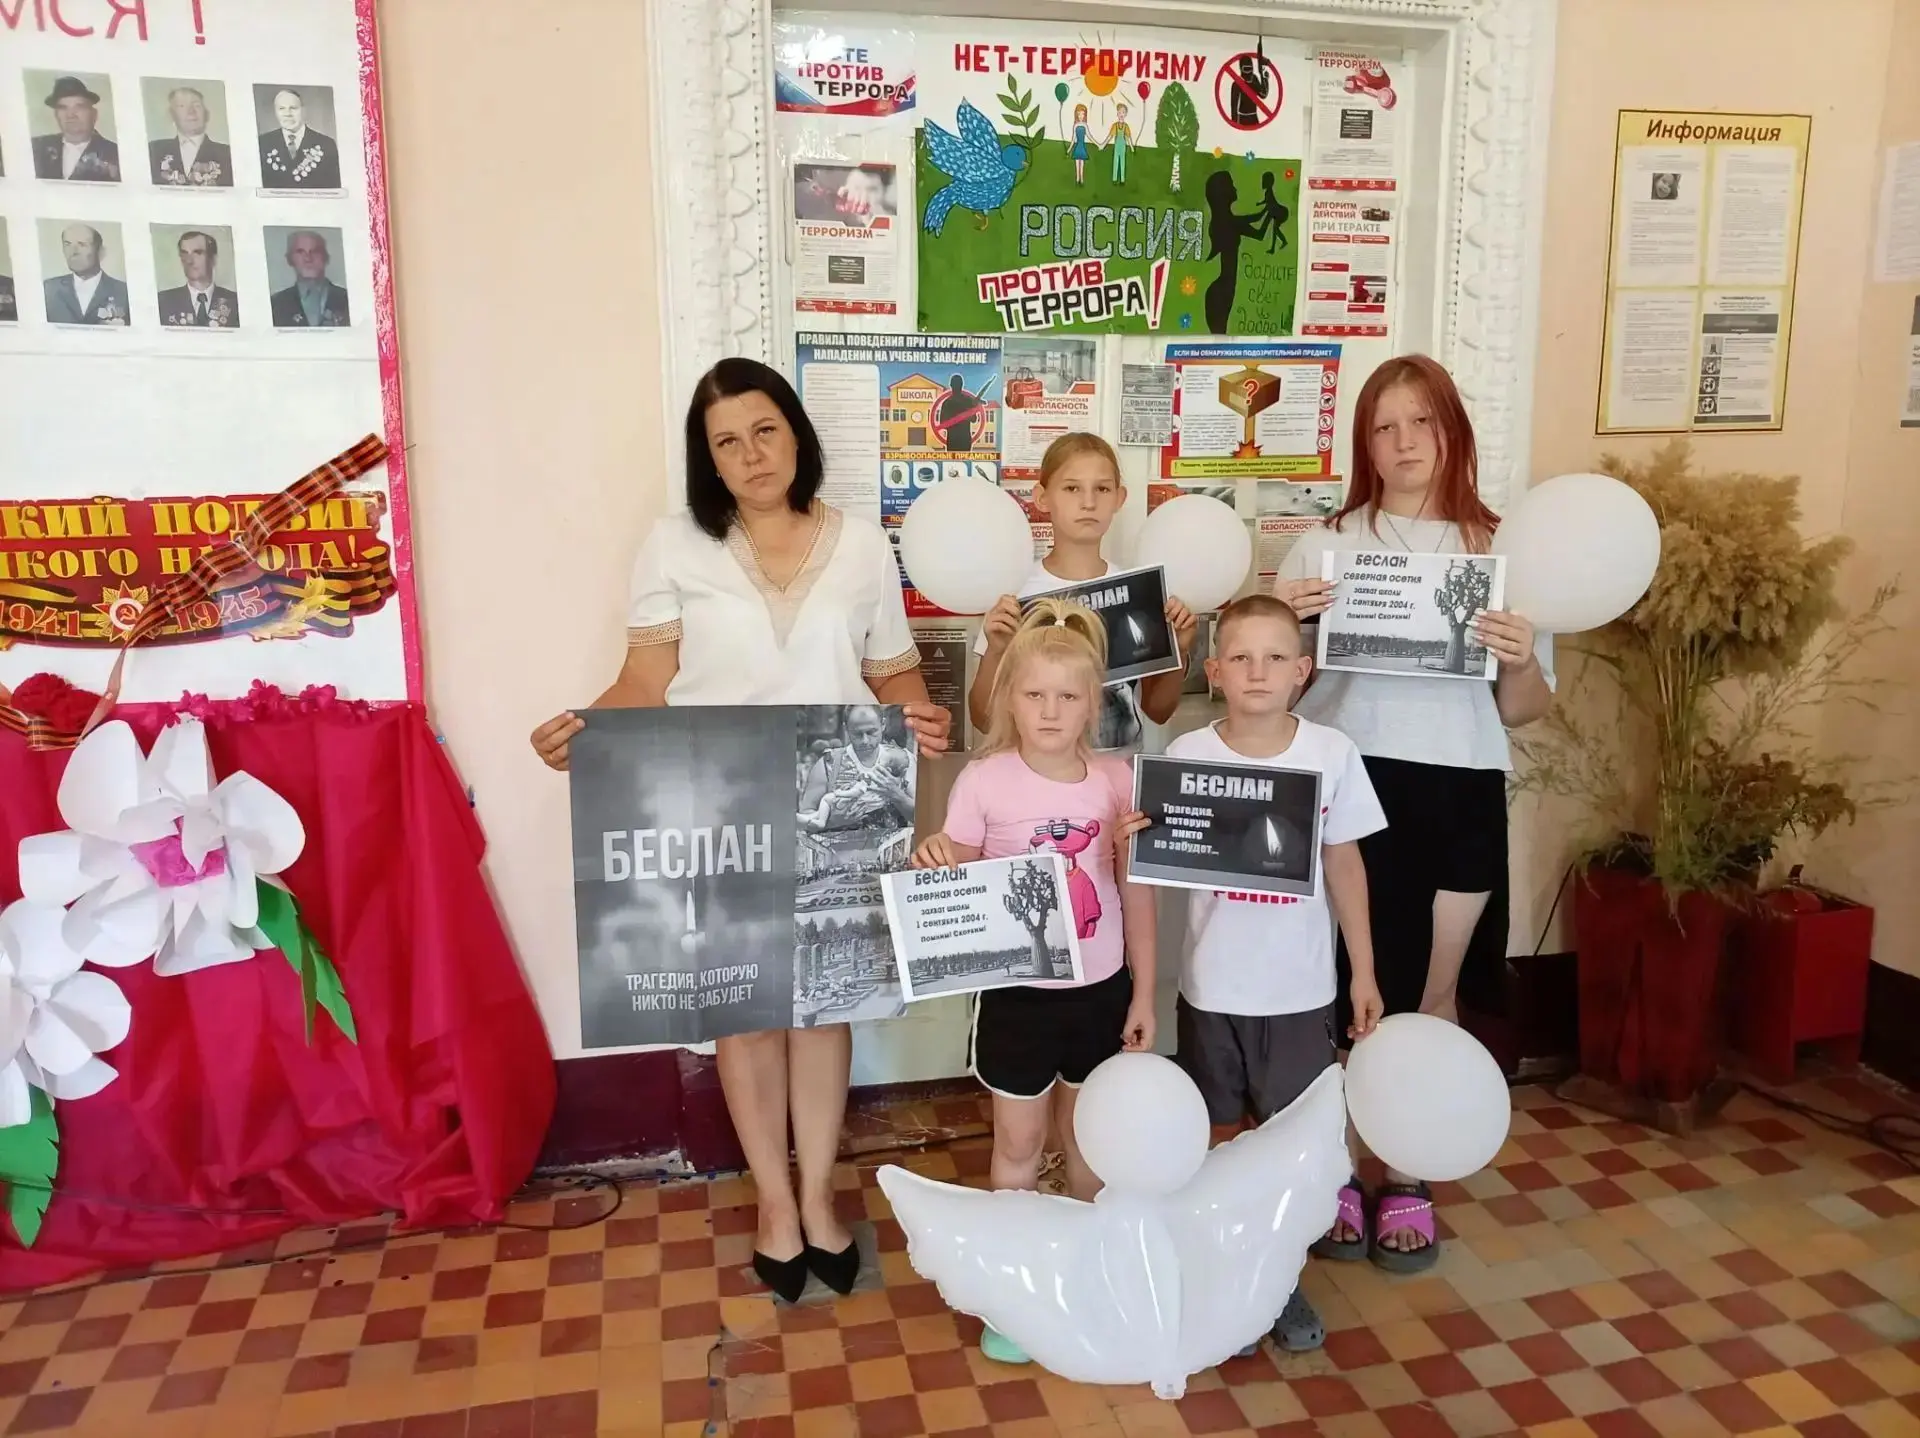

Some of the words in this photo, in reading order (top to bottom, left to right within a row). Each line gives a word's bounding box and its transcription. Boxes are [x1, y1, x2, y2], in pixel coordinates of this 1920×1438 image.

[954, 43, 1207, 81] НЕТ-ТЕРРОРИЗМУ
[1318, 58, 1382, 70] ТЕРРОРИЗМ
[798, 62, 884, 81] ПРОТИВ
[814, 81, 909, 100] ТЕРРОРА
[1646, 119, 1782, 144] Информация
[1312, 201, 1358, 210] АЛГОРИТМ
[1312, 210, 1357, 219] ДЕЙСТВИЙ
[800, 226, 873, 239] ТЕРРОРИЗМ
[1019, 203, 1204, 262] РОССИЯ
[1312, 221, 1336, 232] ПРИ
[1339, 222, 1381, 233] ТЕРАКТЕ
[980, 260, 1102, 300] ПРОТИВ
[798, 333, 845, 346] ПРАВИЛА
[846, 335, 904, 348] ПОВЕДЕНИЯ
[906, 337, 926, 348] ПРИ
[814, 349, 873, 363] НАПАДЕНИИ
[875, 351, 888, 362] НА
[889, 351, 932, 363] УЧЕБНОЕ
[933, 352, 987, 364] ЗАВЕДЕНИЕ
[1302, 349, 1333, 357] ПРЕДМЕТ
[900, 391, 934, 400] ШКОЛА
[885, 452, 953, 460] ВЗРЫВООПАСНЫЕ
[954, 453, 997, 461] ПРЕДМЕТЫ
[157, 535, 360, 578] НОДА!
[1070, 585, 1130, 611] СЛАН
[1345, 597, 1350, 605] 1
[1388, 600, 1408, 610] 2004
[0, 601, 83, 638] 941
[175, 586, 268, 633] 1945
[1180, 771, 1274, 802] БЕСЛАН
[1162, 803, 1215, 818] Трагедия,
[1165, 816, 1211, 829] которую
[1172, 829, 1203, 840] никто
[1154, 840, 1167, 849] не
[602, 823, 773, 882] БЕСЛАН
[961, 914, 980, 923] 2004
[625, 972, 698, 991] ТРАГЕДИЯ,
[700, 963, 759, 987] КОТОРУЮ
[632, 993, 676, 1011] НИКТО
[680, 994, 696, 1011] НЕ
[699, 984, 754, 1009] ЗАБУДЕТ
